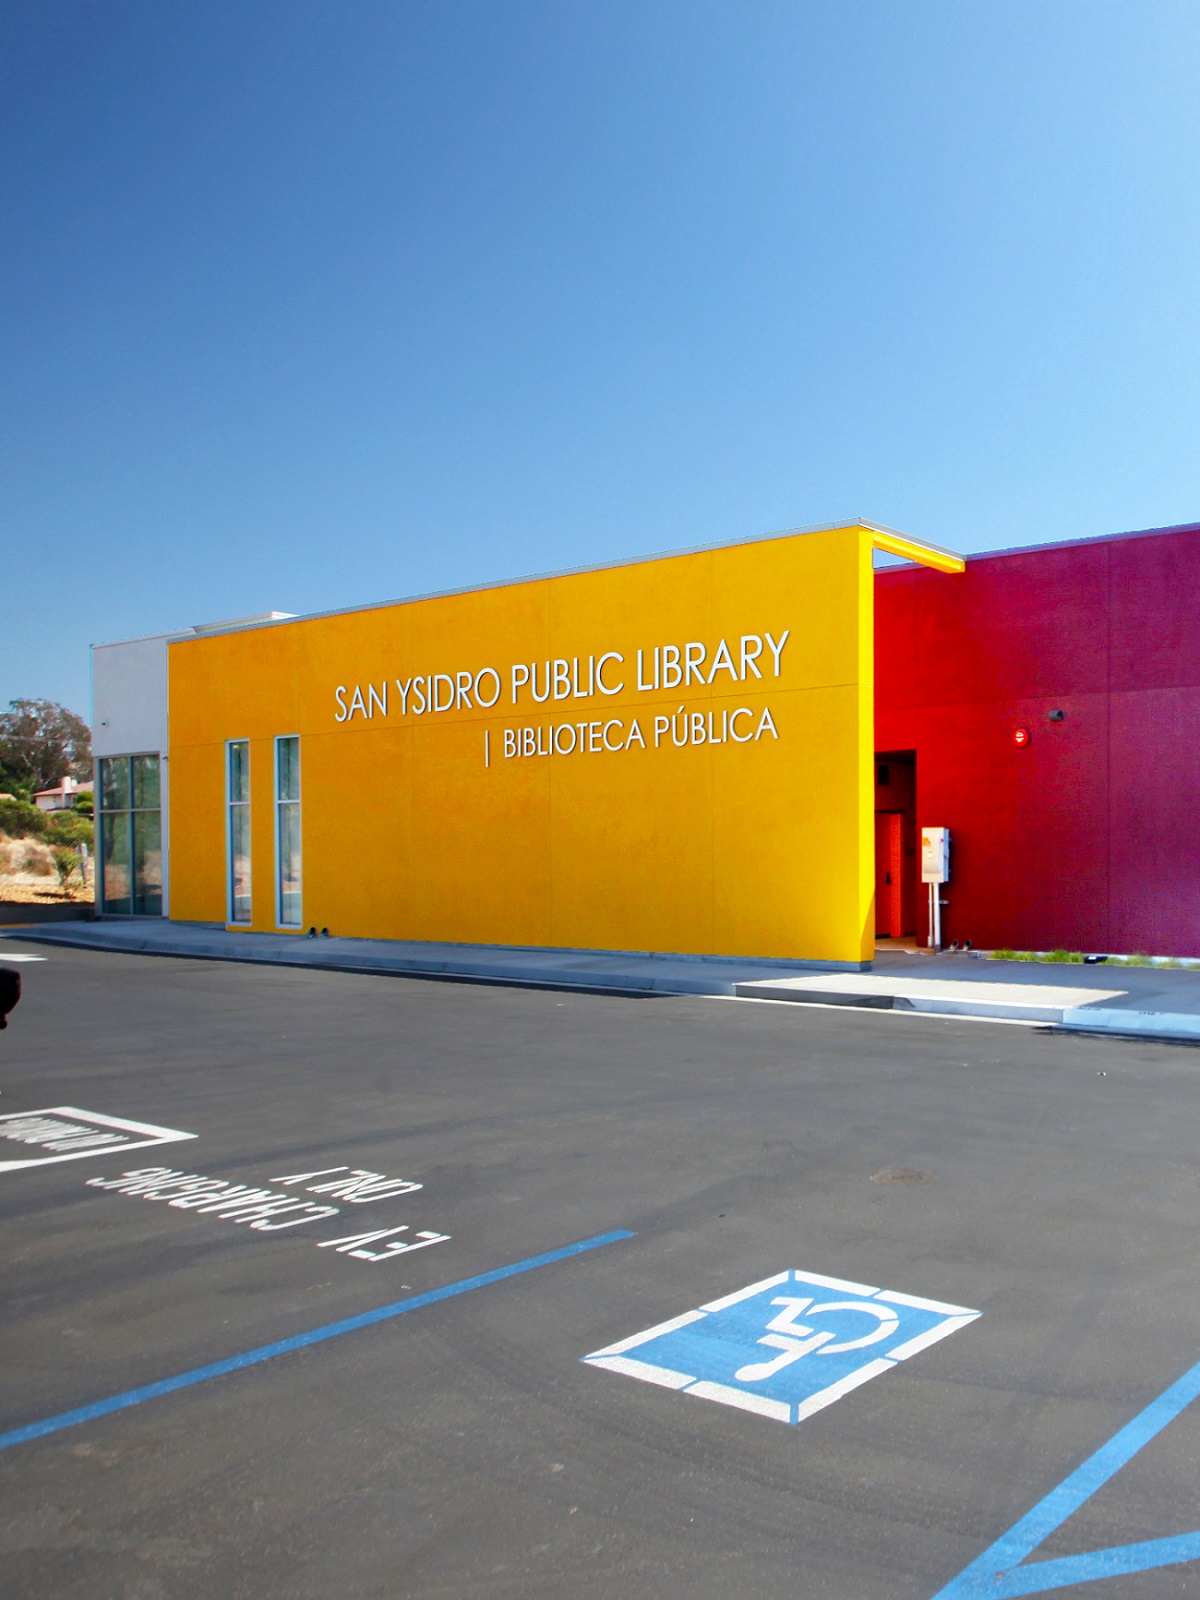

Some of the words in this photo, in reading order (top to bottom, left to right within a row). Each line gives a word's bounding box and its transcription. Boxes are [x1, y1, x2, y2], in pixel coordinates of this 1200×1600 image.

[334, 681, 388, 723] SAN
[395, 667, 501, 715] YSIDRO
[511, 651, 625, 704] PUBLIC
[637, 629, 790, 691] LIBRARY
[504, 719, 646, 758] BIBLIOTECA
[654, 705, 779, 748] PÚBLICA
[85, 1167, 341, 1231] CHARGING
[268, 1166, 424, 1203] ONLY
[316, 1225, 452, 1262] EV
